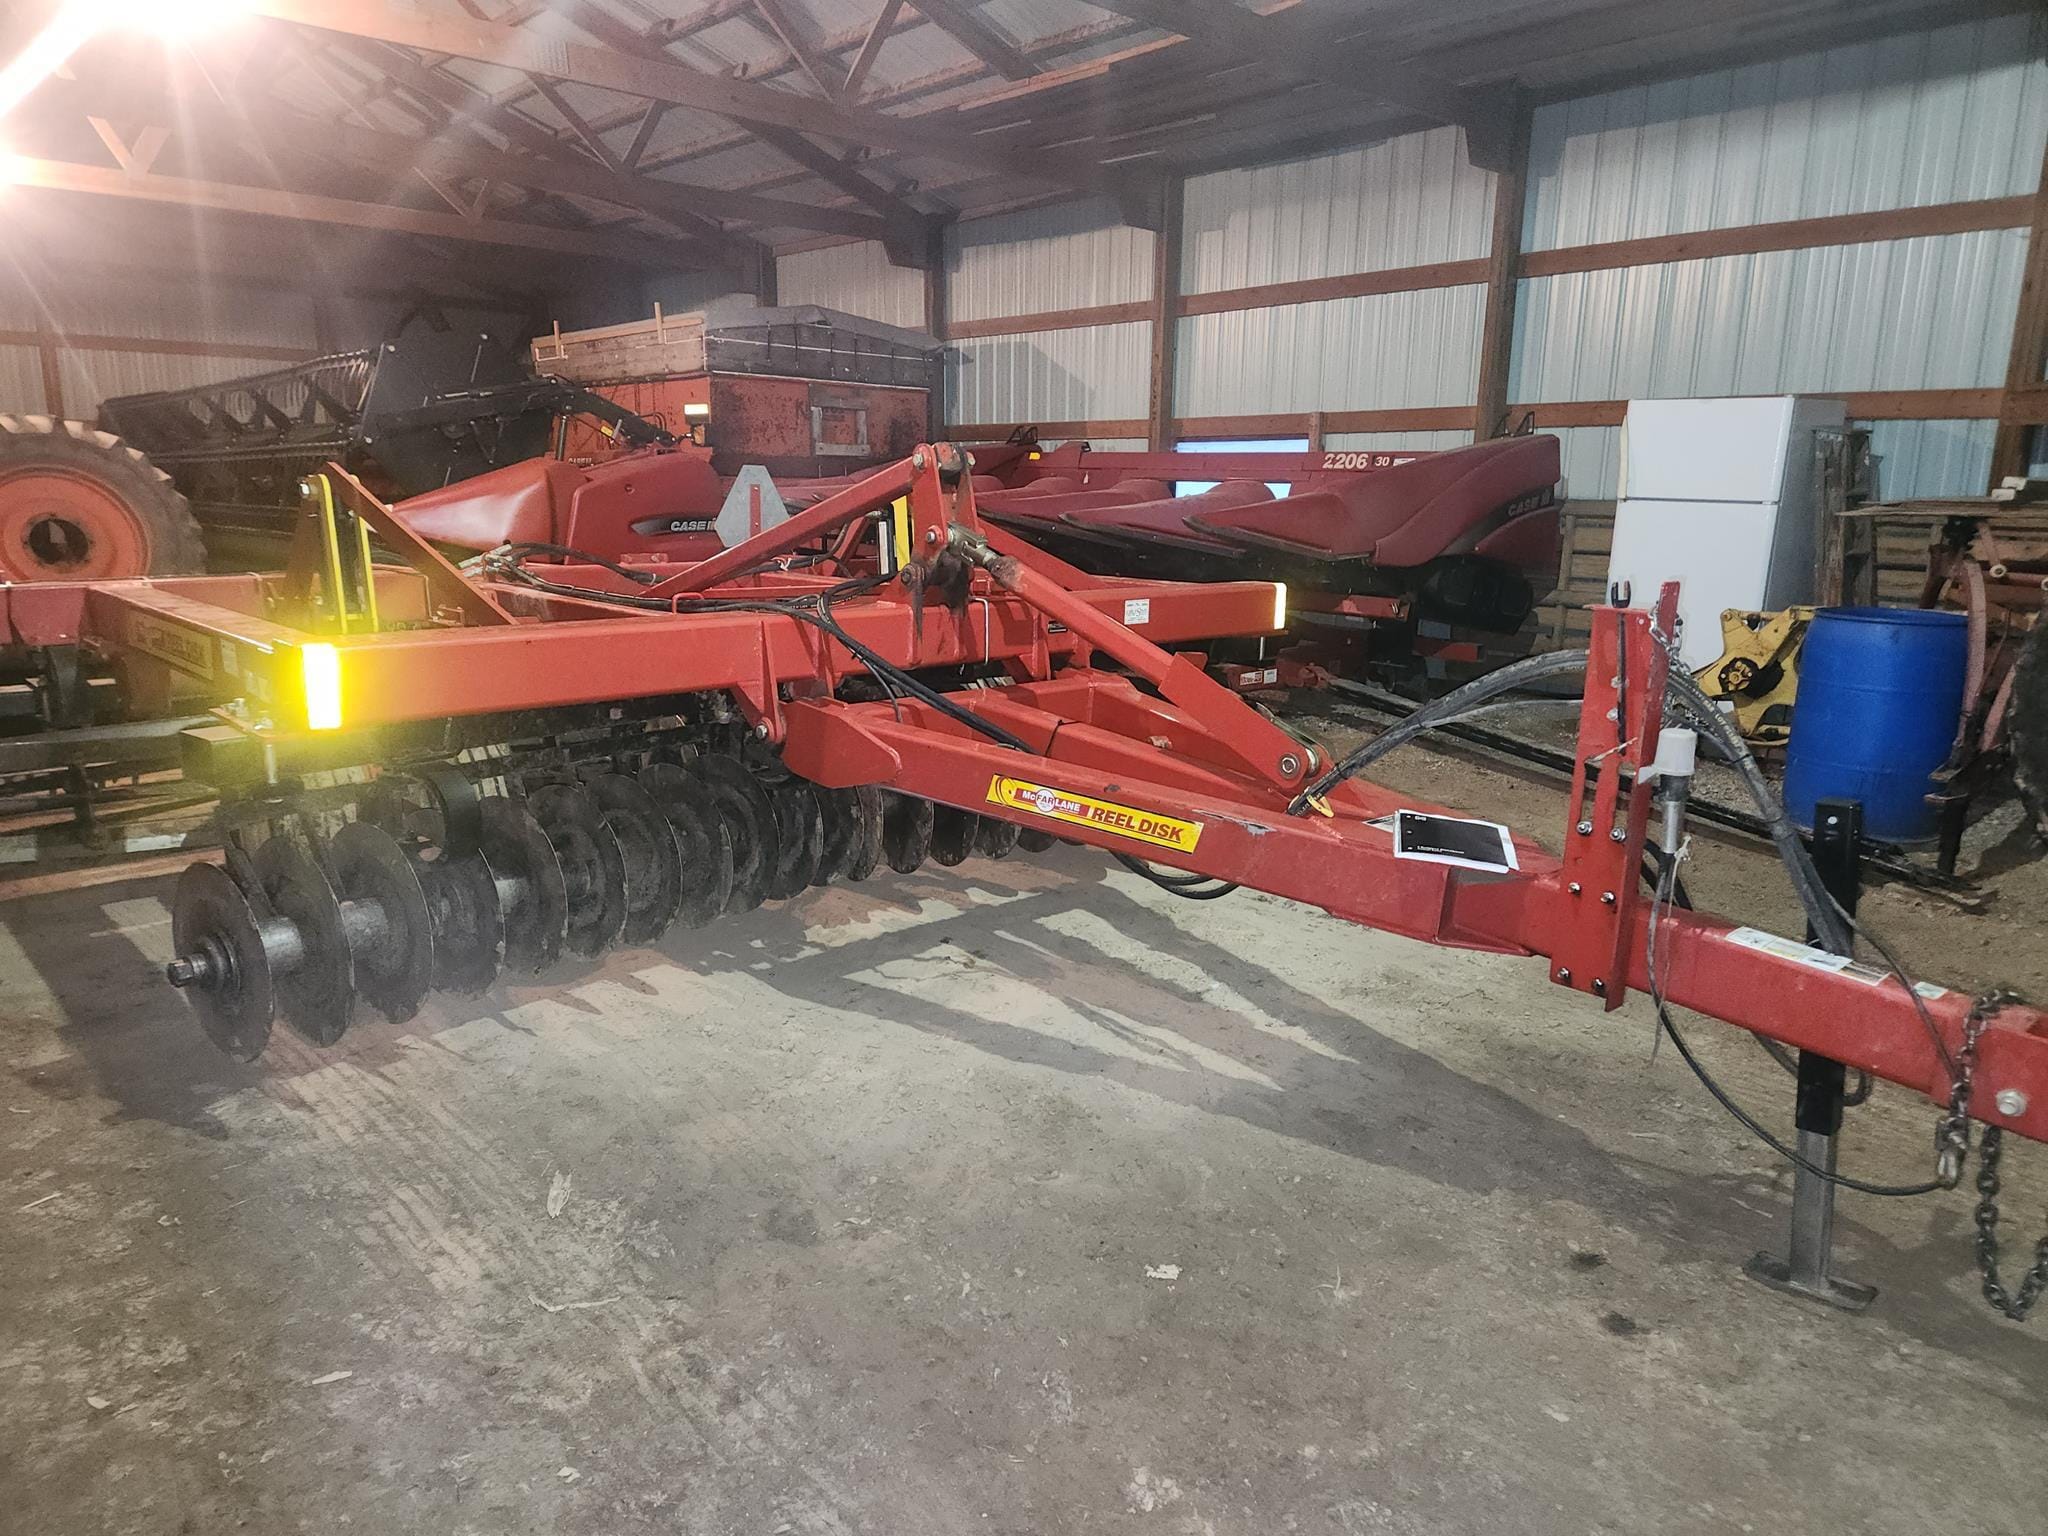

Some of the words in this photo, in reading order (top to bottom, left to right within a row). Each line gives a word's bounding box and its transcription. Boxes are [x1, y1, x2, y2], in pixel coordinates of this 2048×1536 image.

[1322, 453, 1369, 470] 2206
[1374, 456, 1390, 467] 30
[670, 521, 707, 532] CASE
[1091, 807, 1135, 830] REEL
[1138, 816, 1185, 842] DISK
